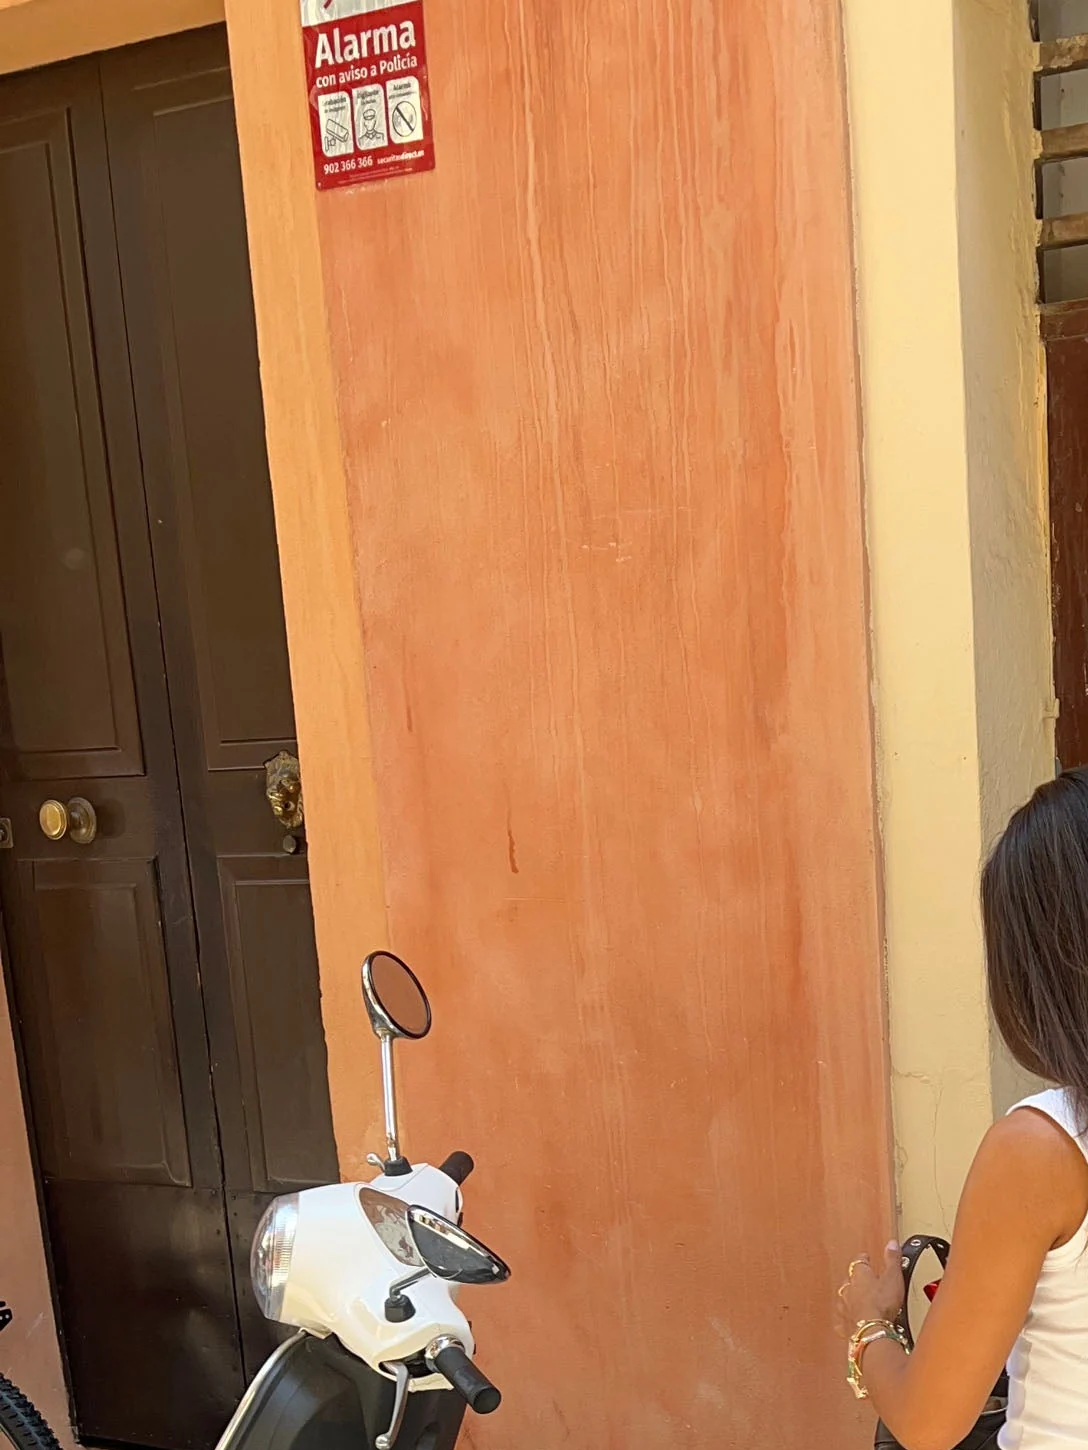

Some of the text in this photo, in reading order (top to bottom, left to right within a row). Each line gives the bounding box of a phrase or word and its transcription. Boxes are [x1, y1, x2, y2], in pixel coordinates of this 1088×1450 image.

[315, 20, 416, 69] Alarma
[316, 52, 418, 88] con aviso a Policía
[323, 161, 340, 175] 902
[340, 159, 356, 171] 366
[357, 156, 373, 168] 366
